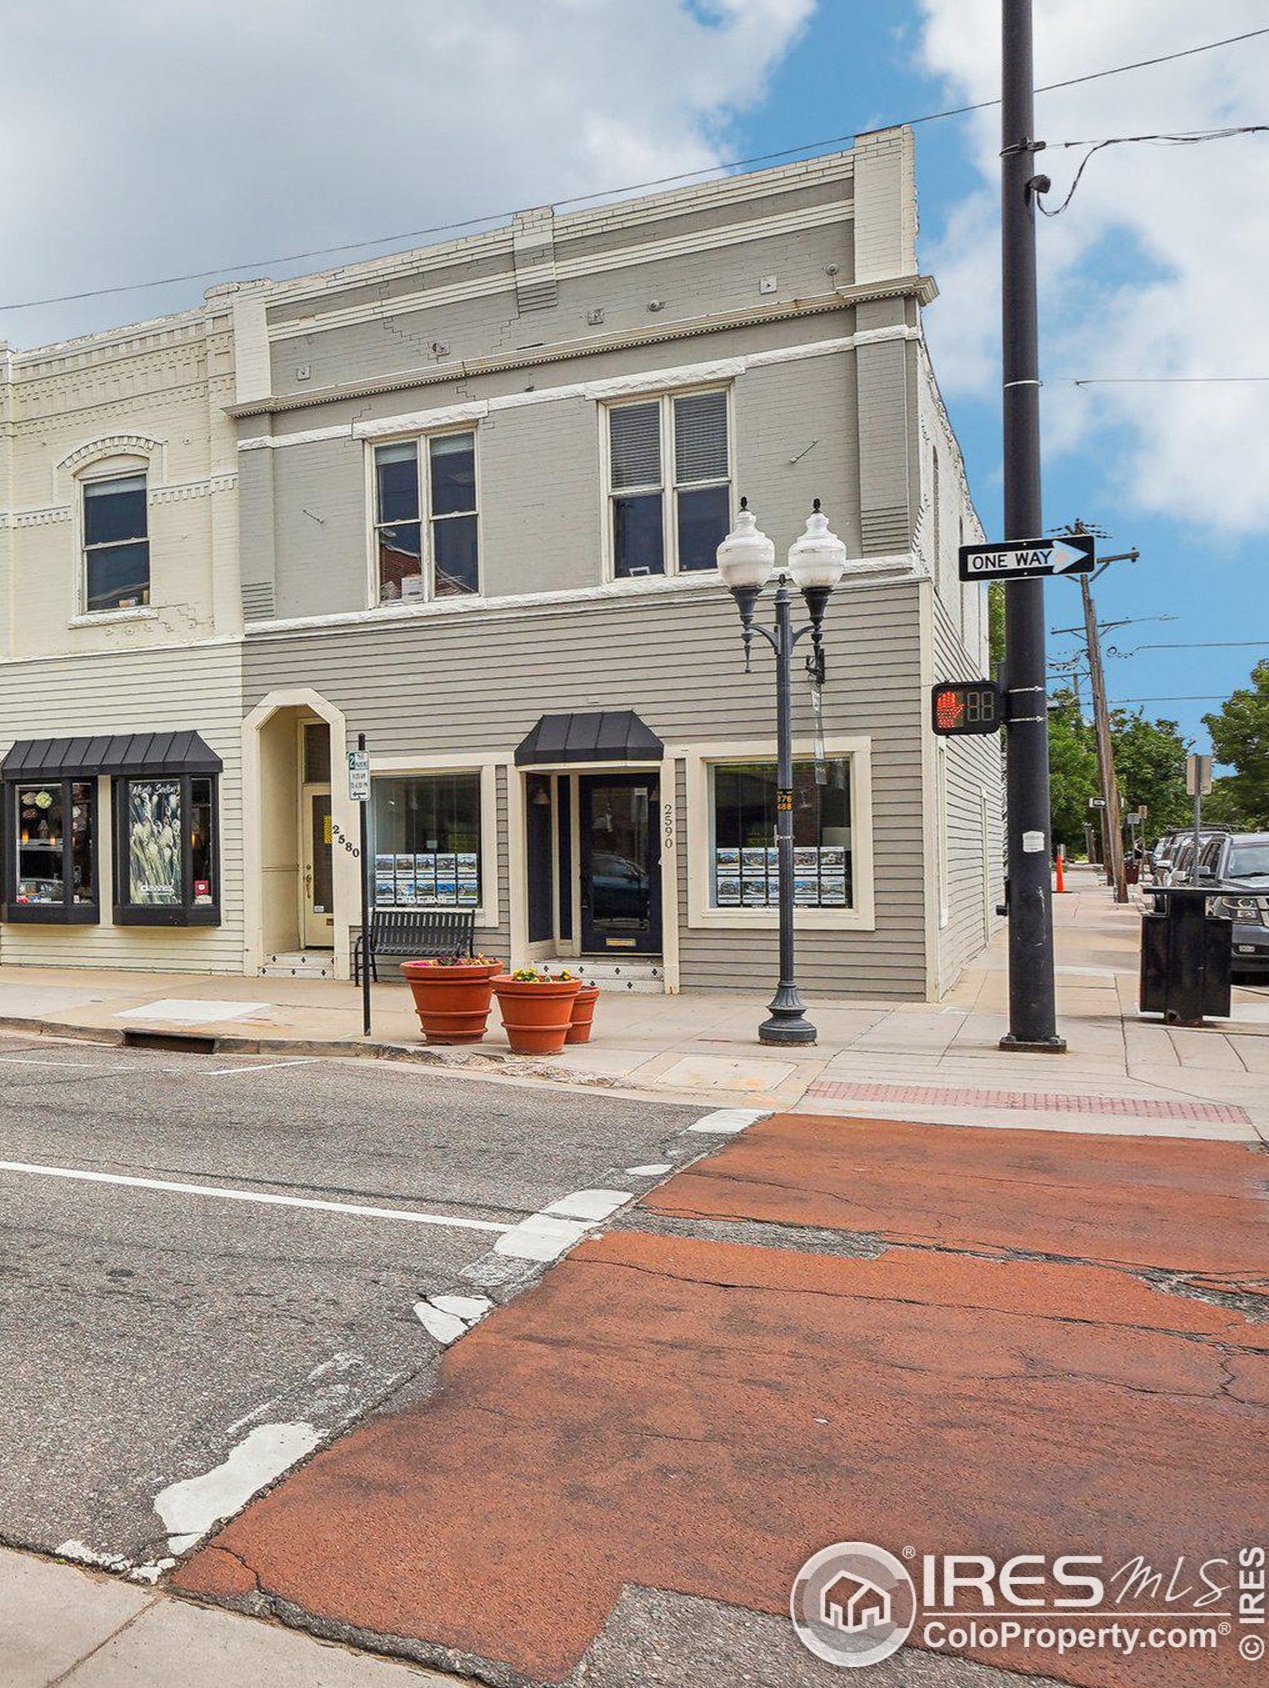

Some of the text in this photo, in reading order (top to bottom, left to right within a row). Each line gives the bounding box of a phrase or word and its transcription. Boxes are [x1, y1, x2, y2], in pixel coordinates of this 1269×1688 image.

[972, 550, 1053, 570] ONE WAY
[331, 824, 360, 858] 2580
[664, 803, 673, 849] 2590
